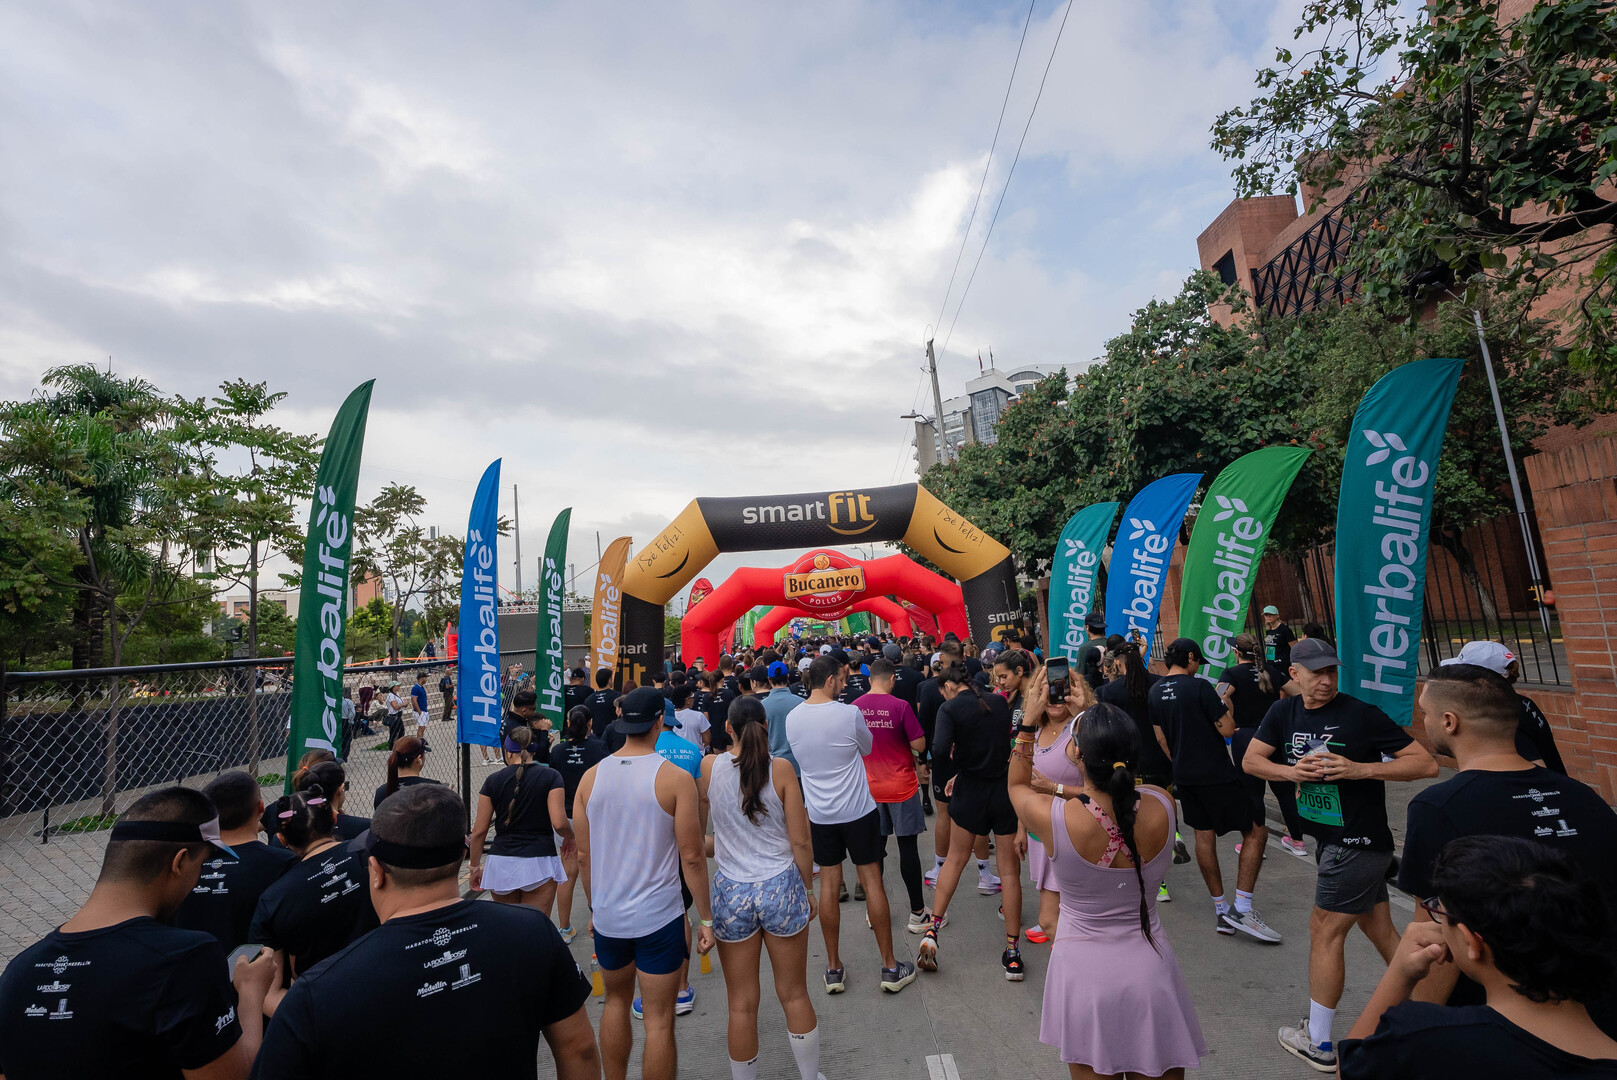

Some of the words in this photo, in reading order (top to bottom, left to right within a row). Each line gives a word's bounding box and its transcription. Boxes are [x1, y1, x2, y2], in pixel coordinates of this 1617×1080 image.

[656, 525, 685, 553] Feliz!
[743, 501, 825, 524] smart
[828, 492, 874, 524] fit
[959, 521, 985, 547] Feliz!
[789, 574, 860, 593] Bucanero
[809, 595, 842, 605] POLLOS
[1059, 550, 1097, 663] Herbalife
[1194, 516, 1263, 685] Herbalife
[1361, 456, 1429, 694] Herbalife
[472, 544, 498, 725] Herbalife
[540, 571, 563, 713] Herbalife
[596, 585, 619, 671] rbalife
